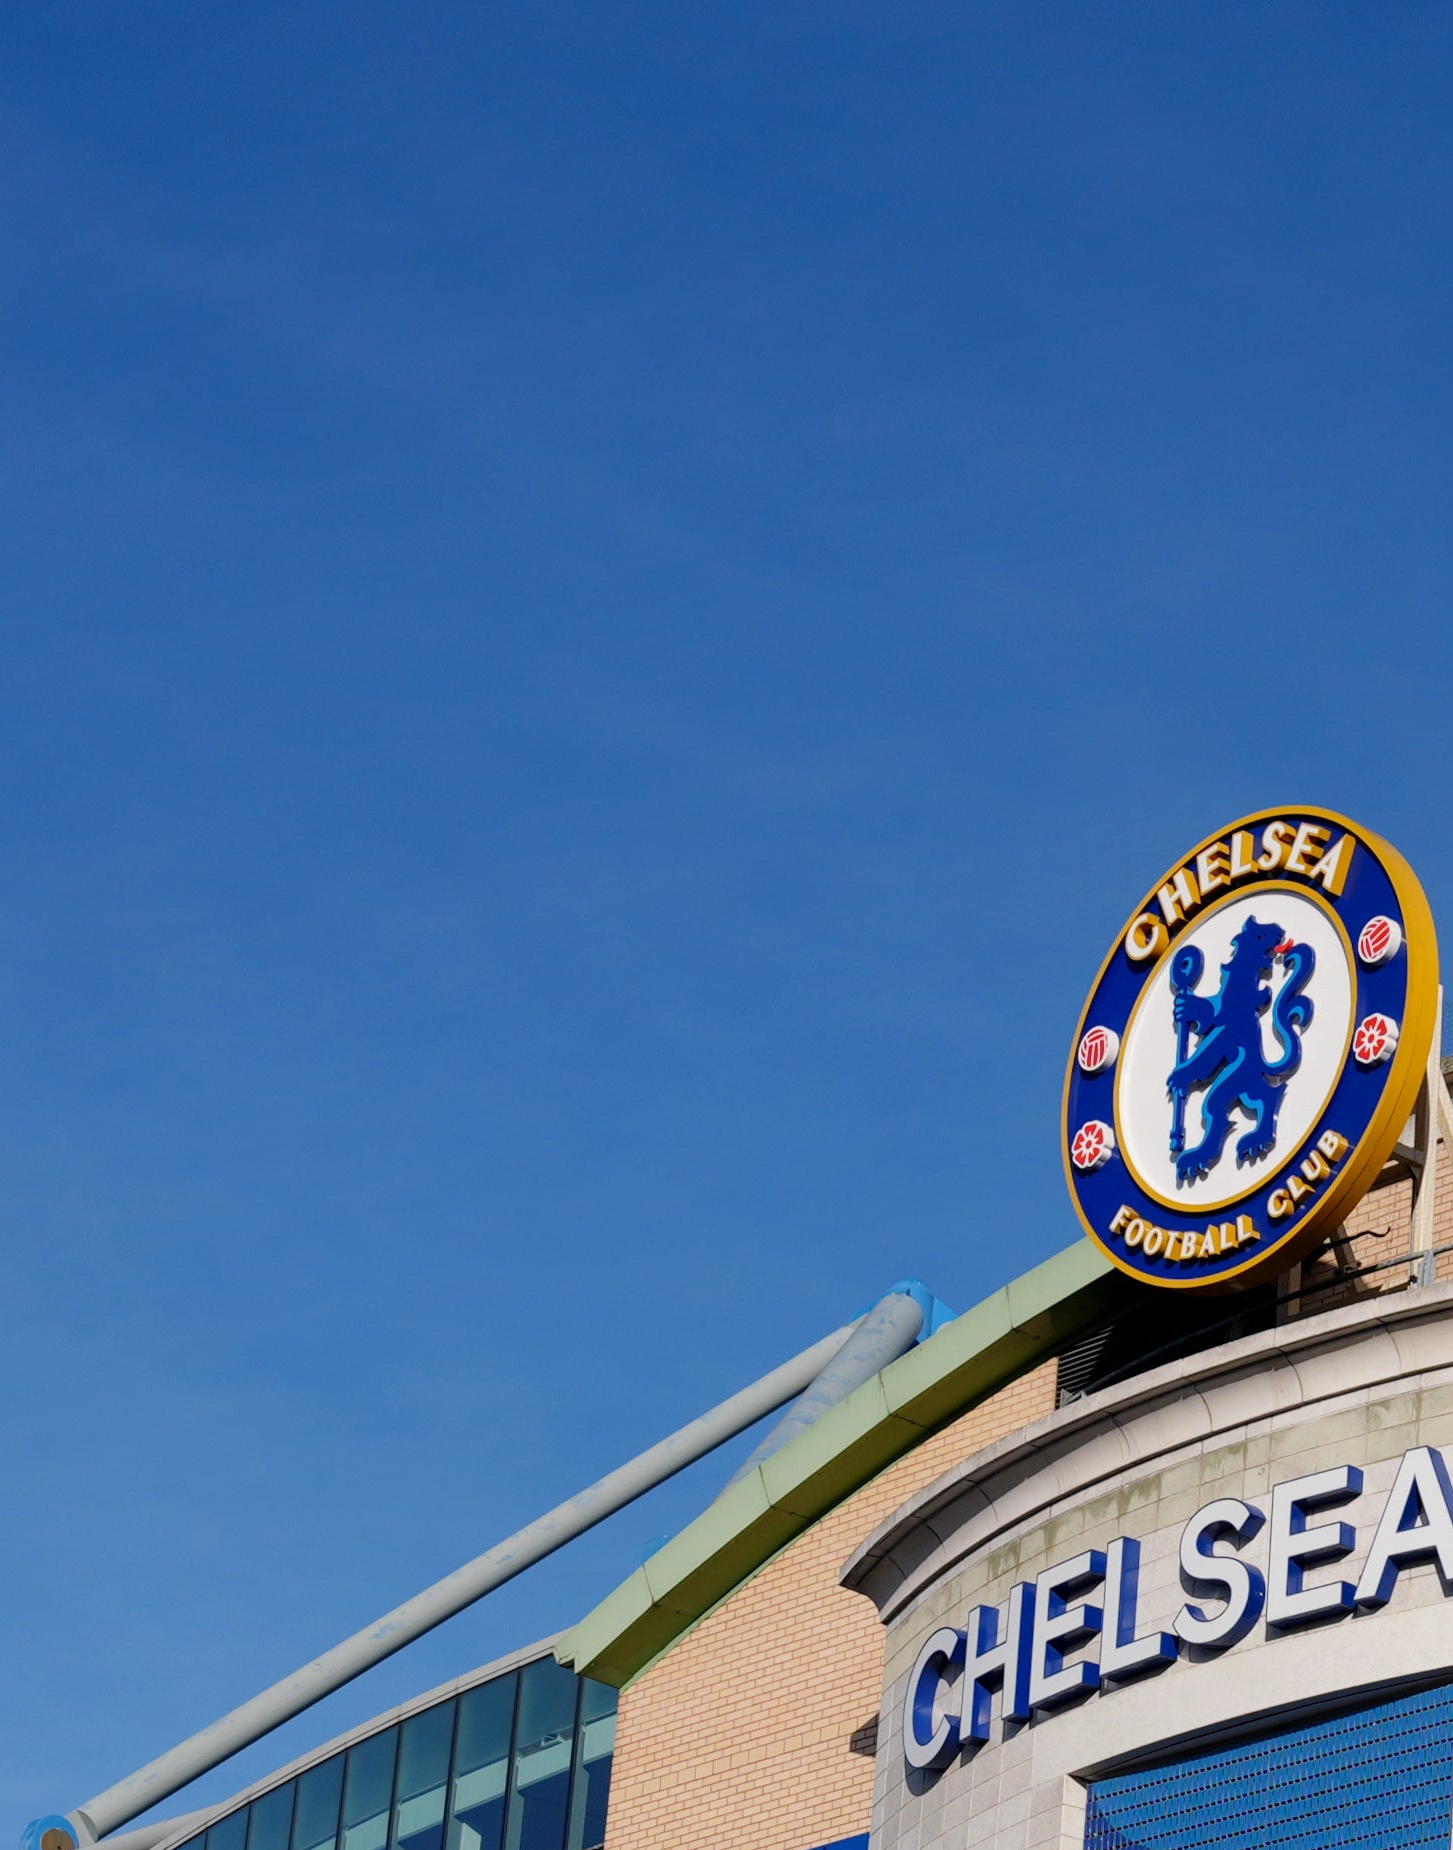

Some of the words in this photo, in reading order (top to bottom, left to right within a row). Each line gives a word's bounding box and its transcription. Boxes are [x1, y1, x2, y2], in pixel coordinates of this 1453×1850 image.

[1125, 820, 1357, 961] CHELSEA
[1108, 1204, 1260, 1260] FOOTBALL
[1267, 1130, 1348, 1219] CLUB
